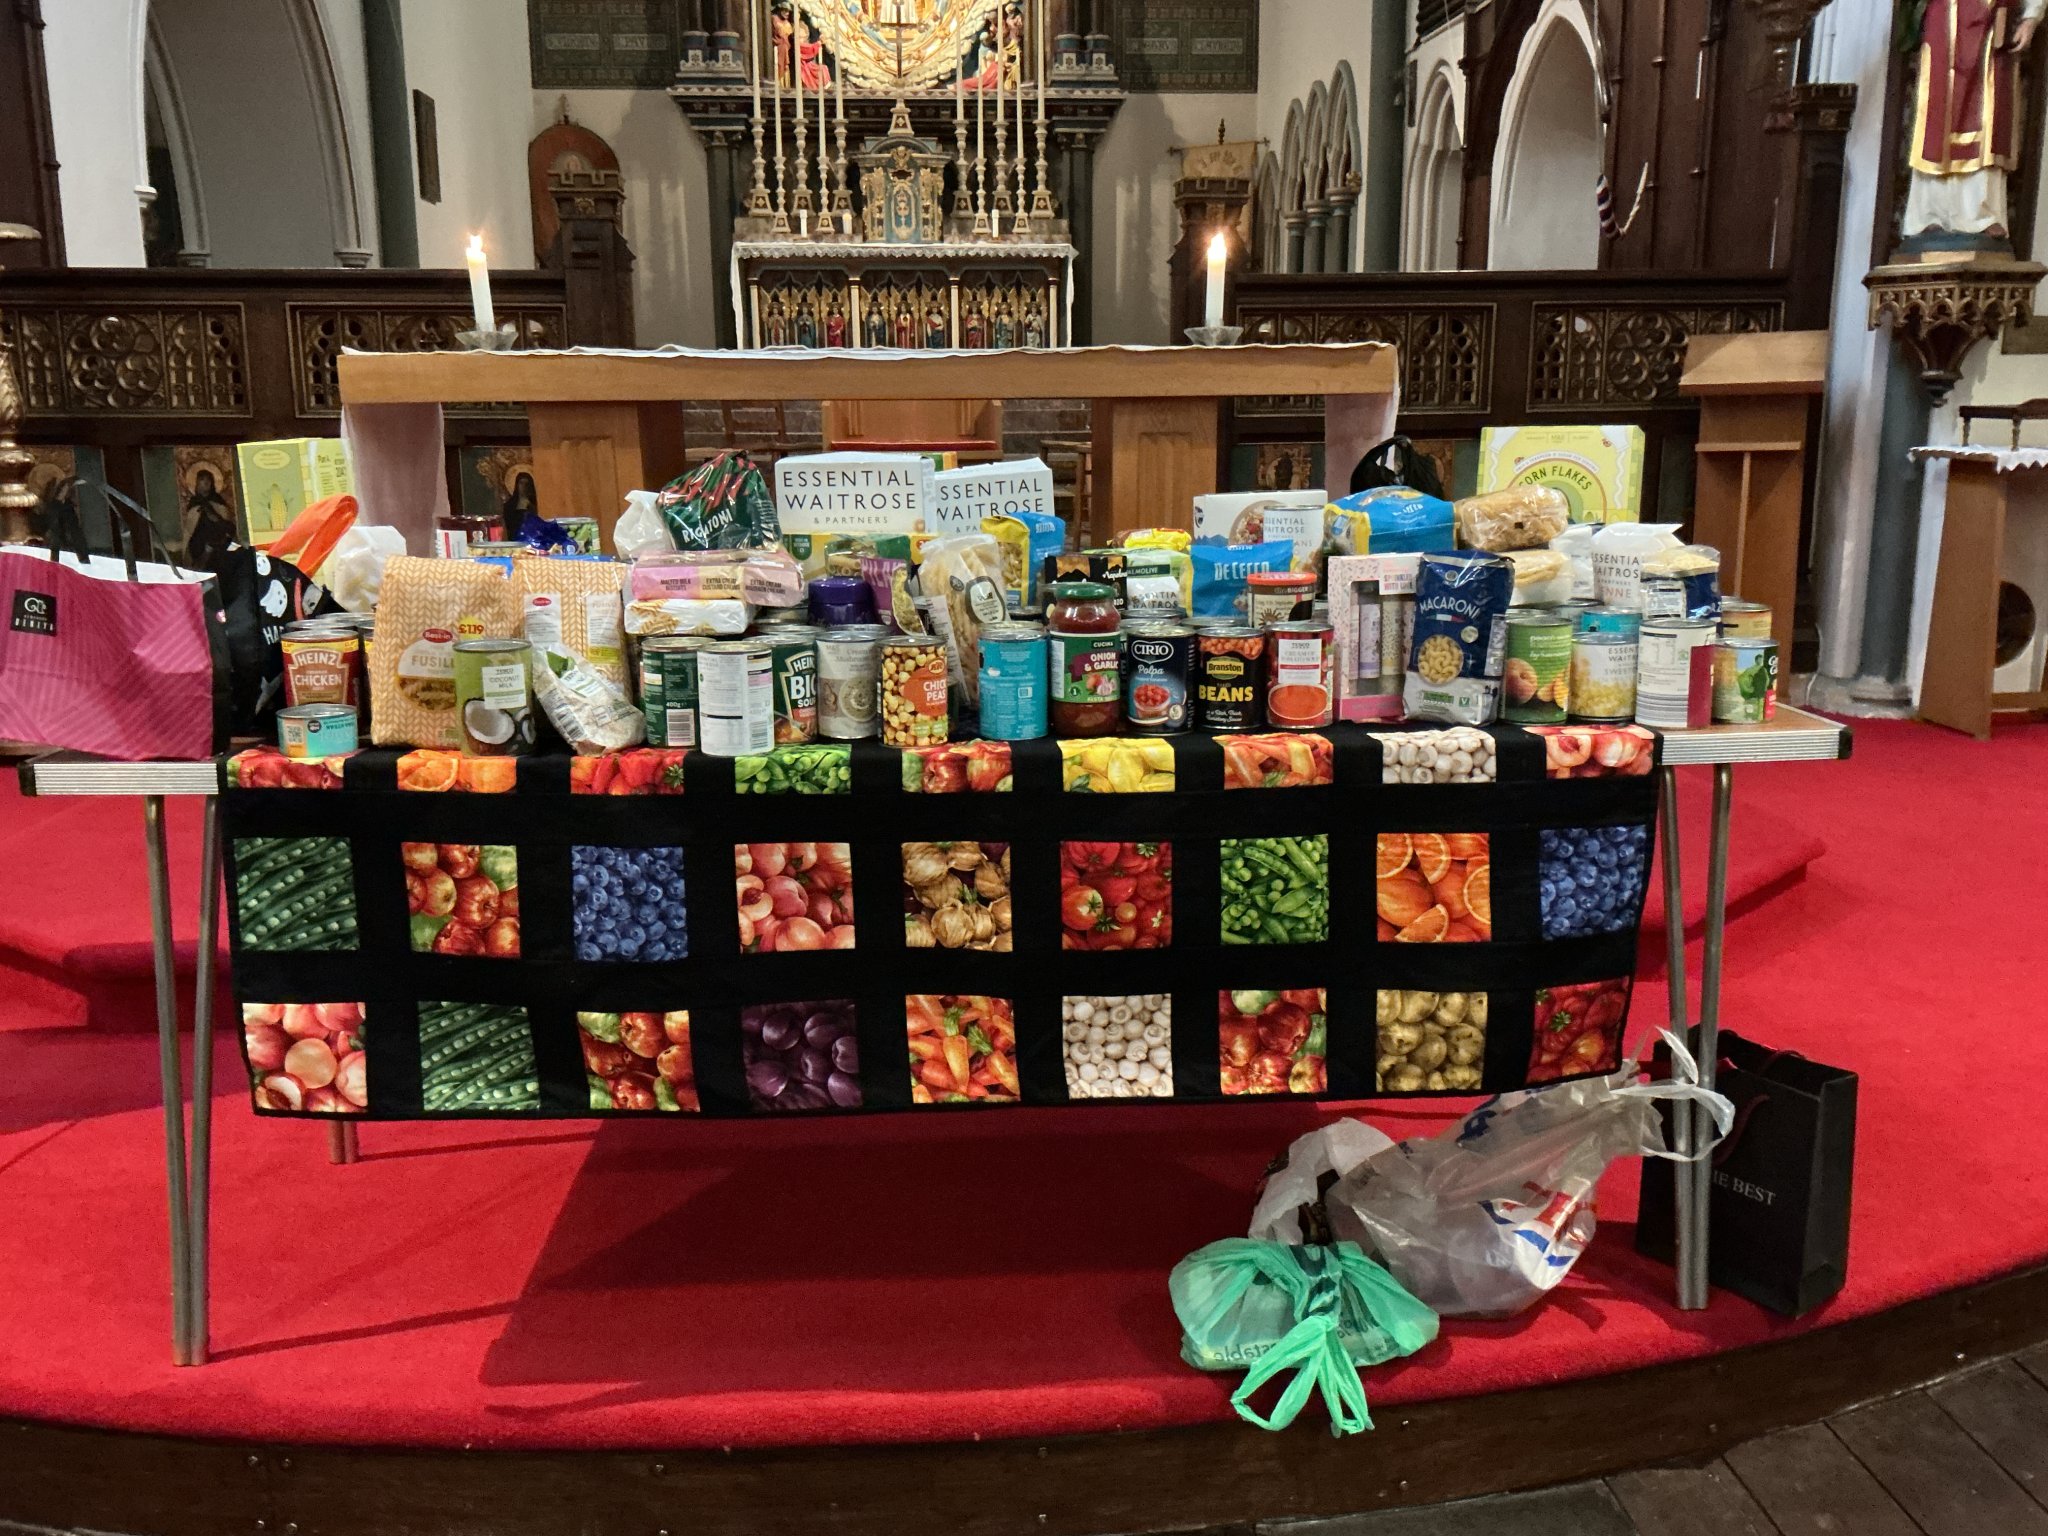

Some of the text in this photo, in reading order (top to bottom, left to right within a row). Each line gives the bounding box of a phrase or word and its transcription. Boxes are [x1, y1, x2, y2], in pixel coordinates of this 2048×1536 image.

[783, 470, 914, 488] ESSENTIAL
[1551, 465, 1592, 491] FLAKES
[940, 477, 1043, 501] SSENTIAL
[784, 493, 916, 511] WAITROSE
[681, 507, 734, 544] RIGATONI
[814, 516, 888, 525] & PARTNERS
[1592, 553, 1640, 565] SSENTIA
[1594, 566, 1640, 579] AITROS
[1600, 586, 1632, 599] ENNE
[1132, 600, 1178, 609] WAITROS
[1419, 595, 1481, 620] MACARONI
[1090, 651, 1116, 662] ONION
[1134, 644, 1170, 656] CIRIO
[296, 652, 337, 667] HEINZ
[1084, 660, 1119, 672] & GARLIC
[1137, 664, 1165, 678] Polpa
[1208, 663, 1242, 673] Branston
[295, 673, 342, 687] CHICKEN
[489, 674, 519, 683] COCONUT
[923, 679, 947, 691] CHIC
[926, 690, 946, 702] PEAS
[1198, 684, 1254, 702] BEANS
[797, 698, 816, 708] SOU
[1732, 1176, 1776, 1206] BEST
